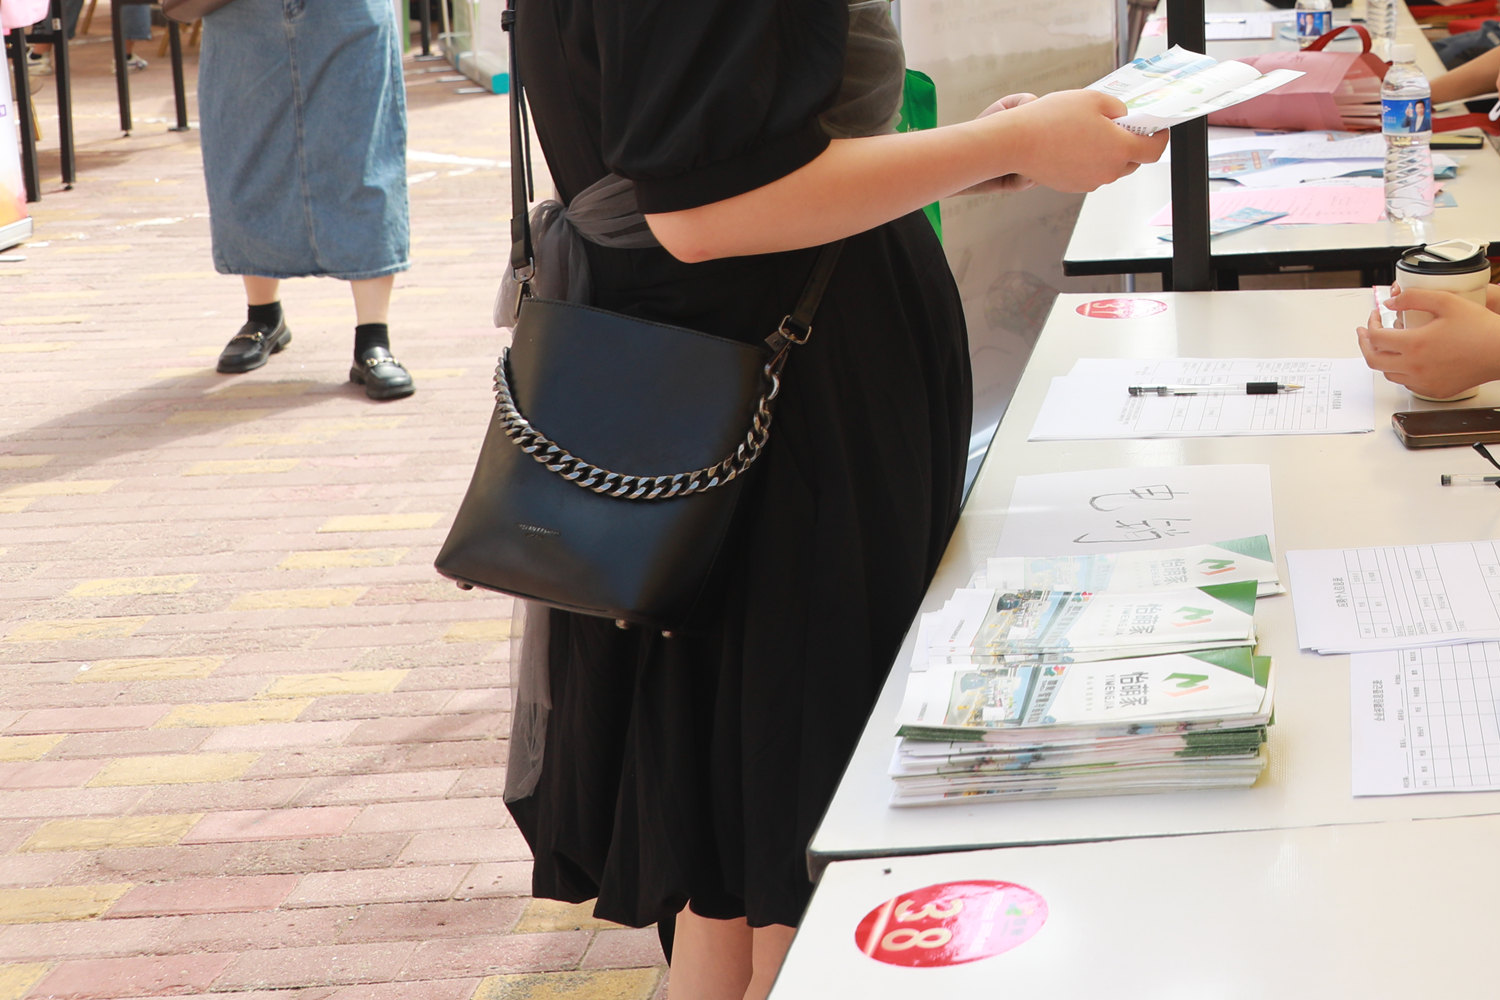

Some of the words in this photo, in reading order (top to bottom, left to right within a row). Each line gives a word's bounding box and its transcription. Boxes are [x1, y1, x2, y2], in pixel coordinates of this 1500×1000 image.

[1129, 603, 1162, 635] 怡萌家
[1119, 671, 1149, 708] 怡萌家
[881, 898, 964, 951] 38
